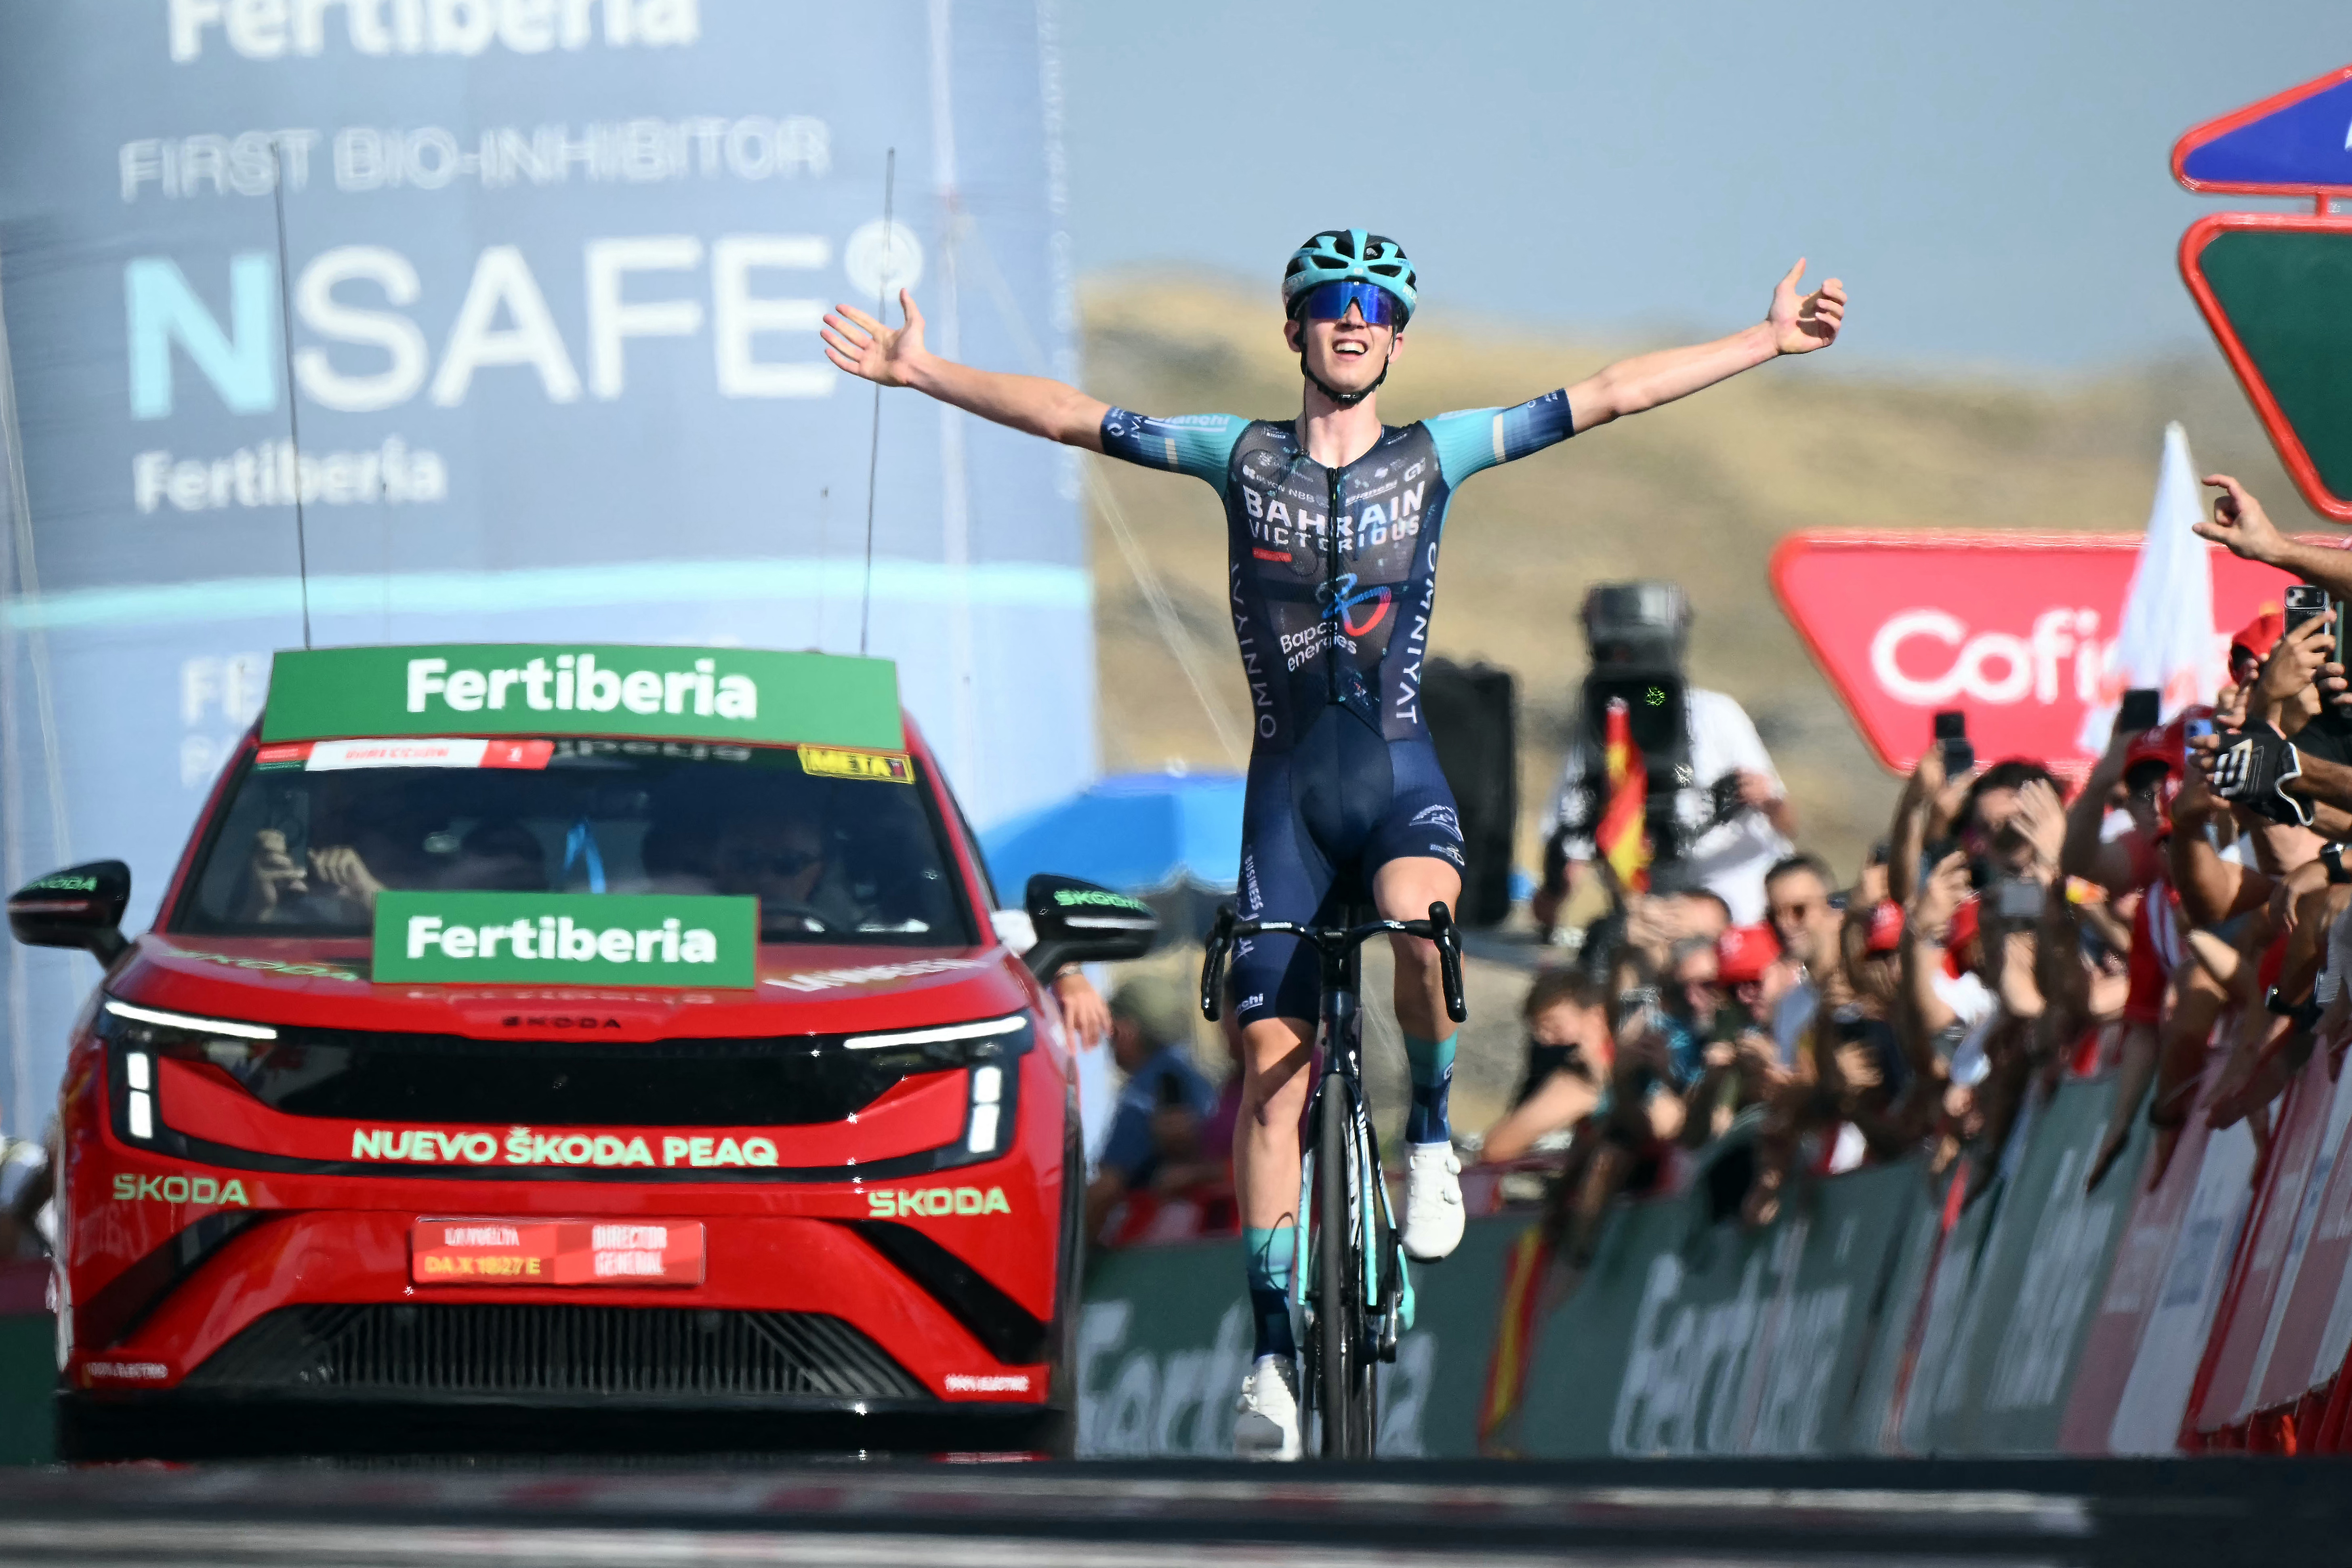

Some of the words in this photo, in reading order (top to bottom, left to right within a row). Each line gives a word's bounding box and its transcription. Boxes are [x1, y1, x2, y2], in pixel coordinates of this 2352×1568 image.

[118, 126, 319, 204] FIRST
[332, 114, 831, 193] BIO-INHIBITOR
[132, 434, 448, 514] Fertiberia
[1289, 488, 1315, 503] NBB
[1243, 481, 1425, 538] BAHRAIN
[1250, 514, 1421, 553] VICTORIOUS
[1279, 621, 1338, 655] Bapco
[1396, 542, 1437, 724] OMNIYAT
[1871, 607, 2234, 706] Cofi
[406, 654, 759, 720] Fertiberia
[407, 915, 717, 963] Fertiberia
[351, 1128, 498, 1162] NUEVO
[505, 1126, 654, 1167] ŠKODA
[662, 1136, 779, 1167] PEAQ
[113, 1173, 249, 1206] SKODA
[868, 1186, 1012, 1217] SKODA
[526, 1257, 540, 1275] E
